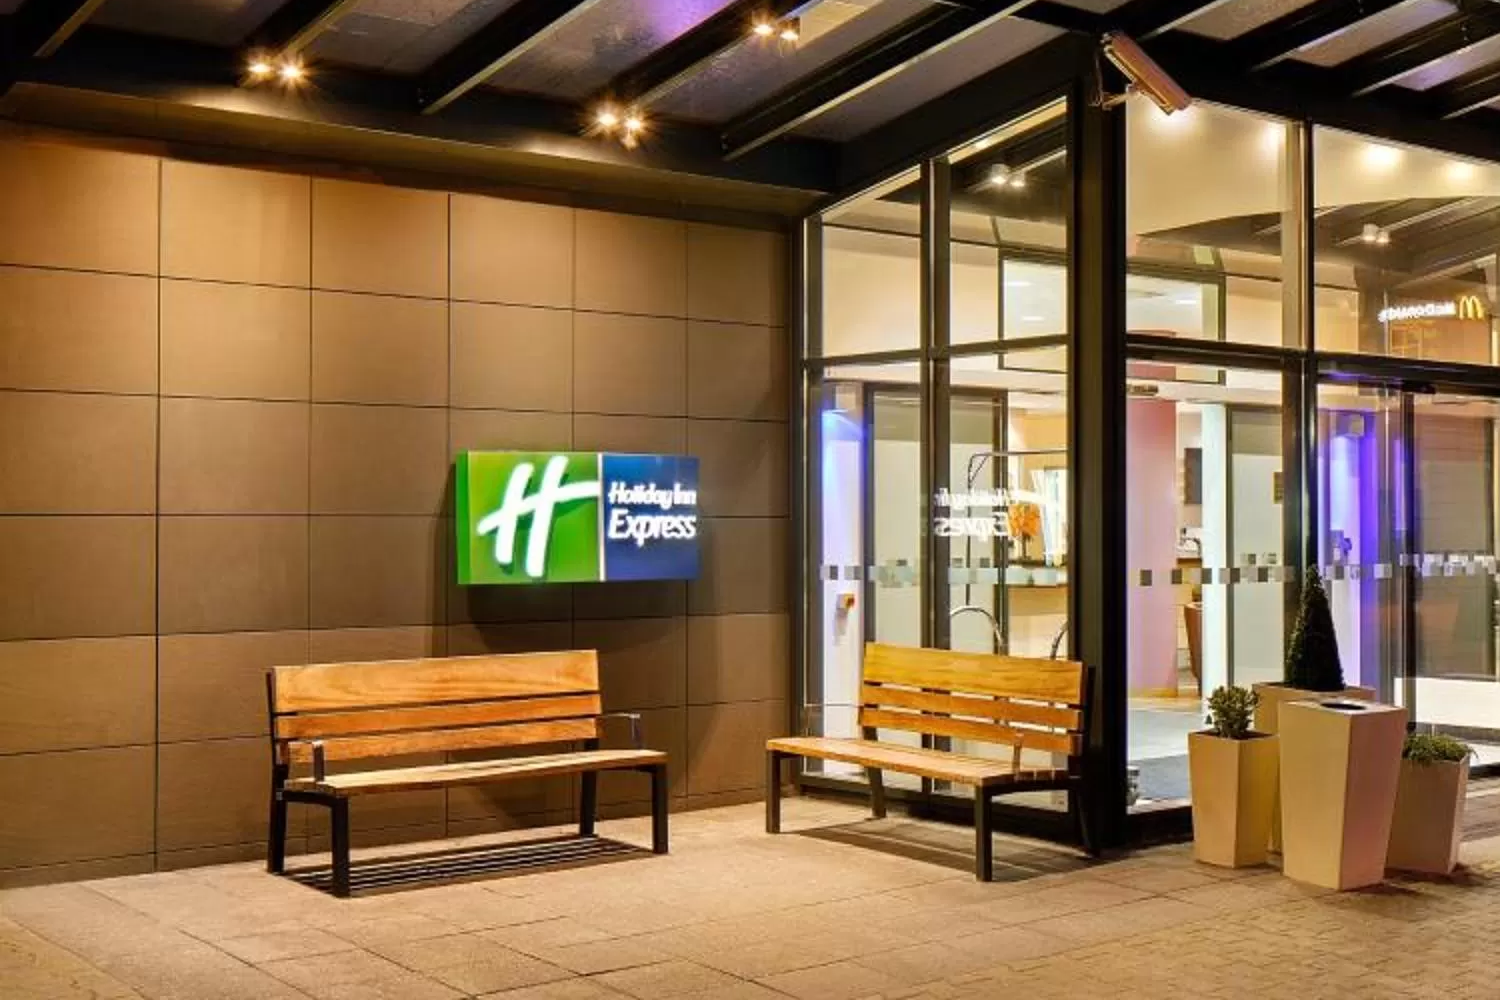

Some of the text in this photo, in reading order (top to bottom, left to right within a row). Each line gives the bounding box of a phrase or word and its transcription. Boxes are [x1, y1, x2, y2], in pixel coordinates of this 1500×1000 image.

[608, 481, 697, 510] Holiday Inn
[607, 508, 697, 547] Express
